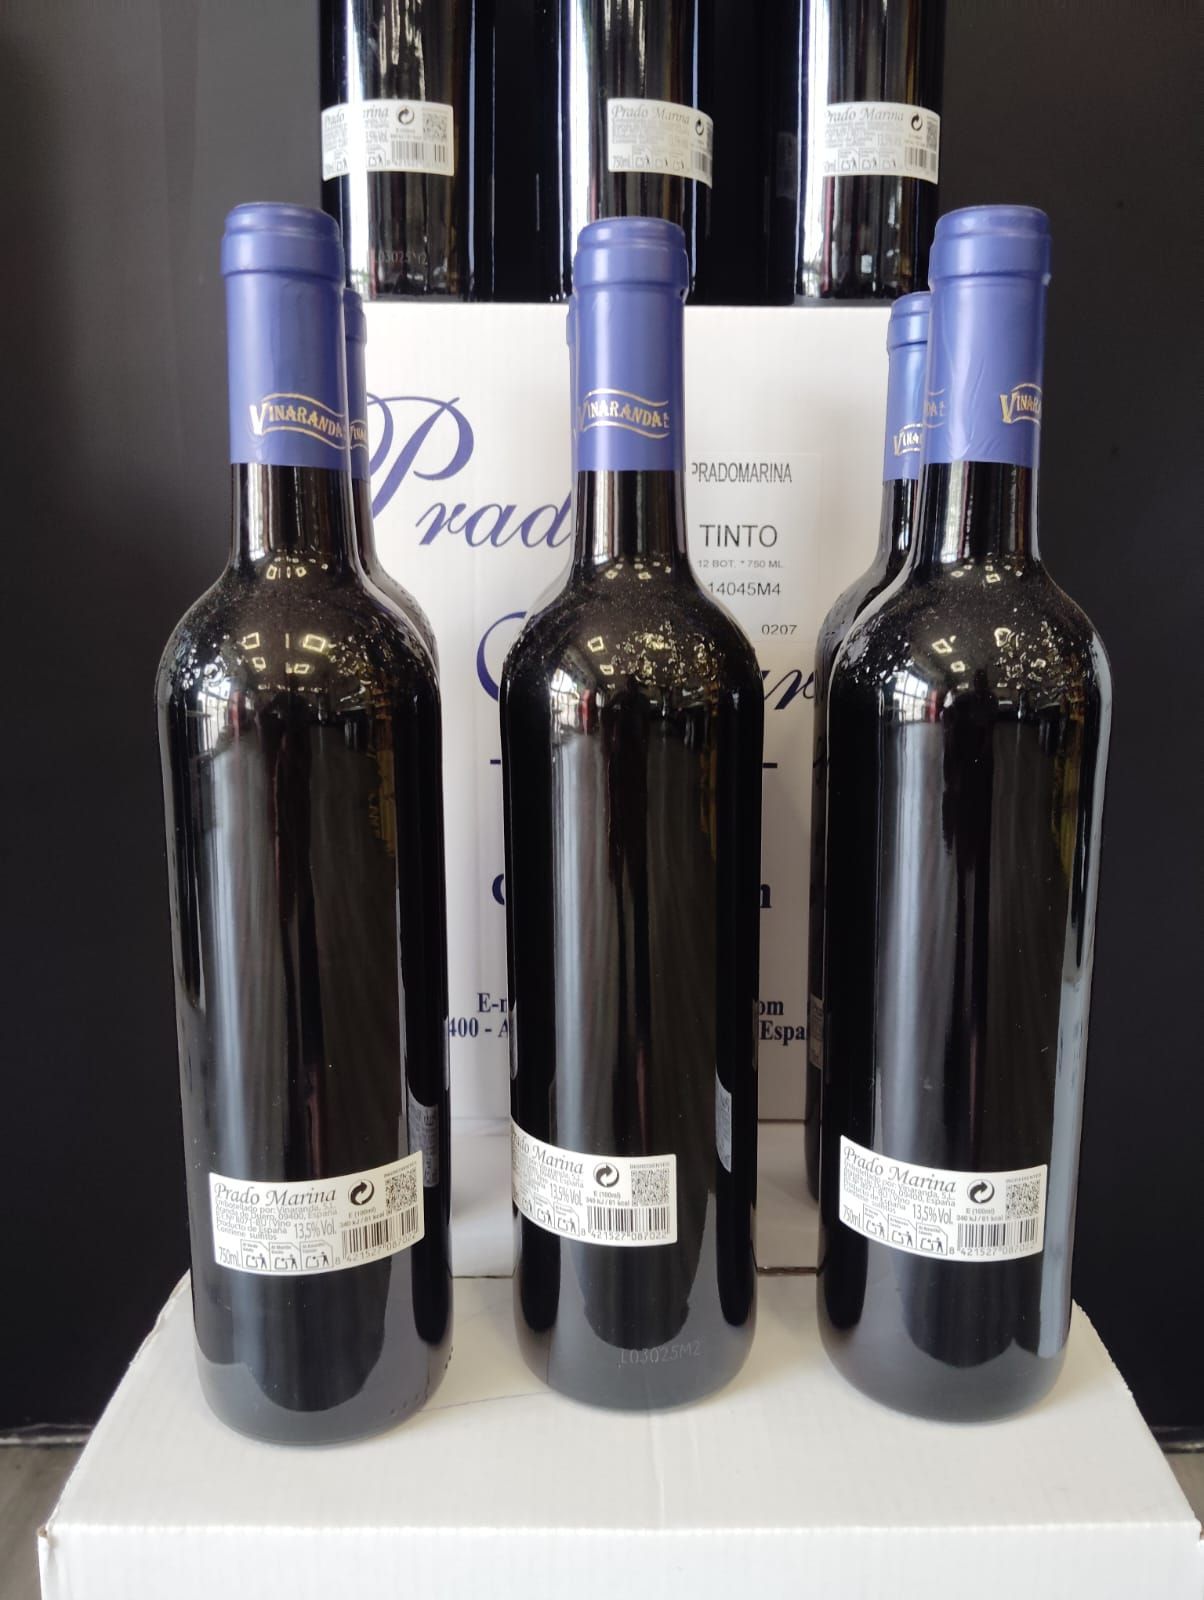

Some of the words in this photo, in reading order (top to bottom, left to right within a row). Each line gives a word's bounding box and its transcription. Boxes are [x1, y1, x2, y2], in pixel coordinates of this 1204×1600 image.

[859, 107, 904, 121] Marina
[699, 524, 778, 548] TINTO
[698, 560, 710, 568] 12
[761, 624, 798, 636] 0207
[532, 1144, 584, 1174] Marina
[843, 1145, 883, 1176] Prado
[888, 1166, 956, 1193] Marina
[214, 1182, 260, 1205] Prado
[265, 1187, 336, 1207] Marina
[912, 1203, 938, 1224] 13,5%
[294, 1221, 321, 1240] 13,5%
[949, 1247, 955, 1255] 8
[960, 1247, 998, 1257] 421527
